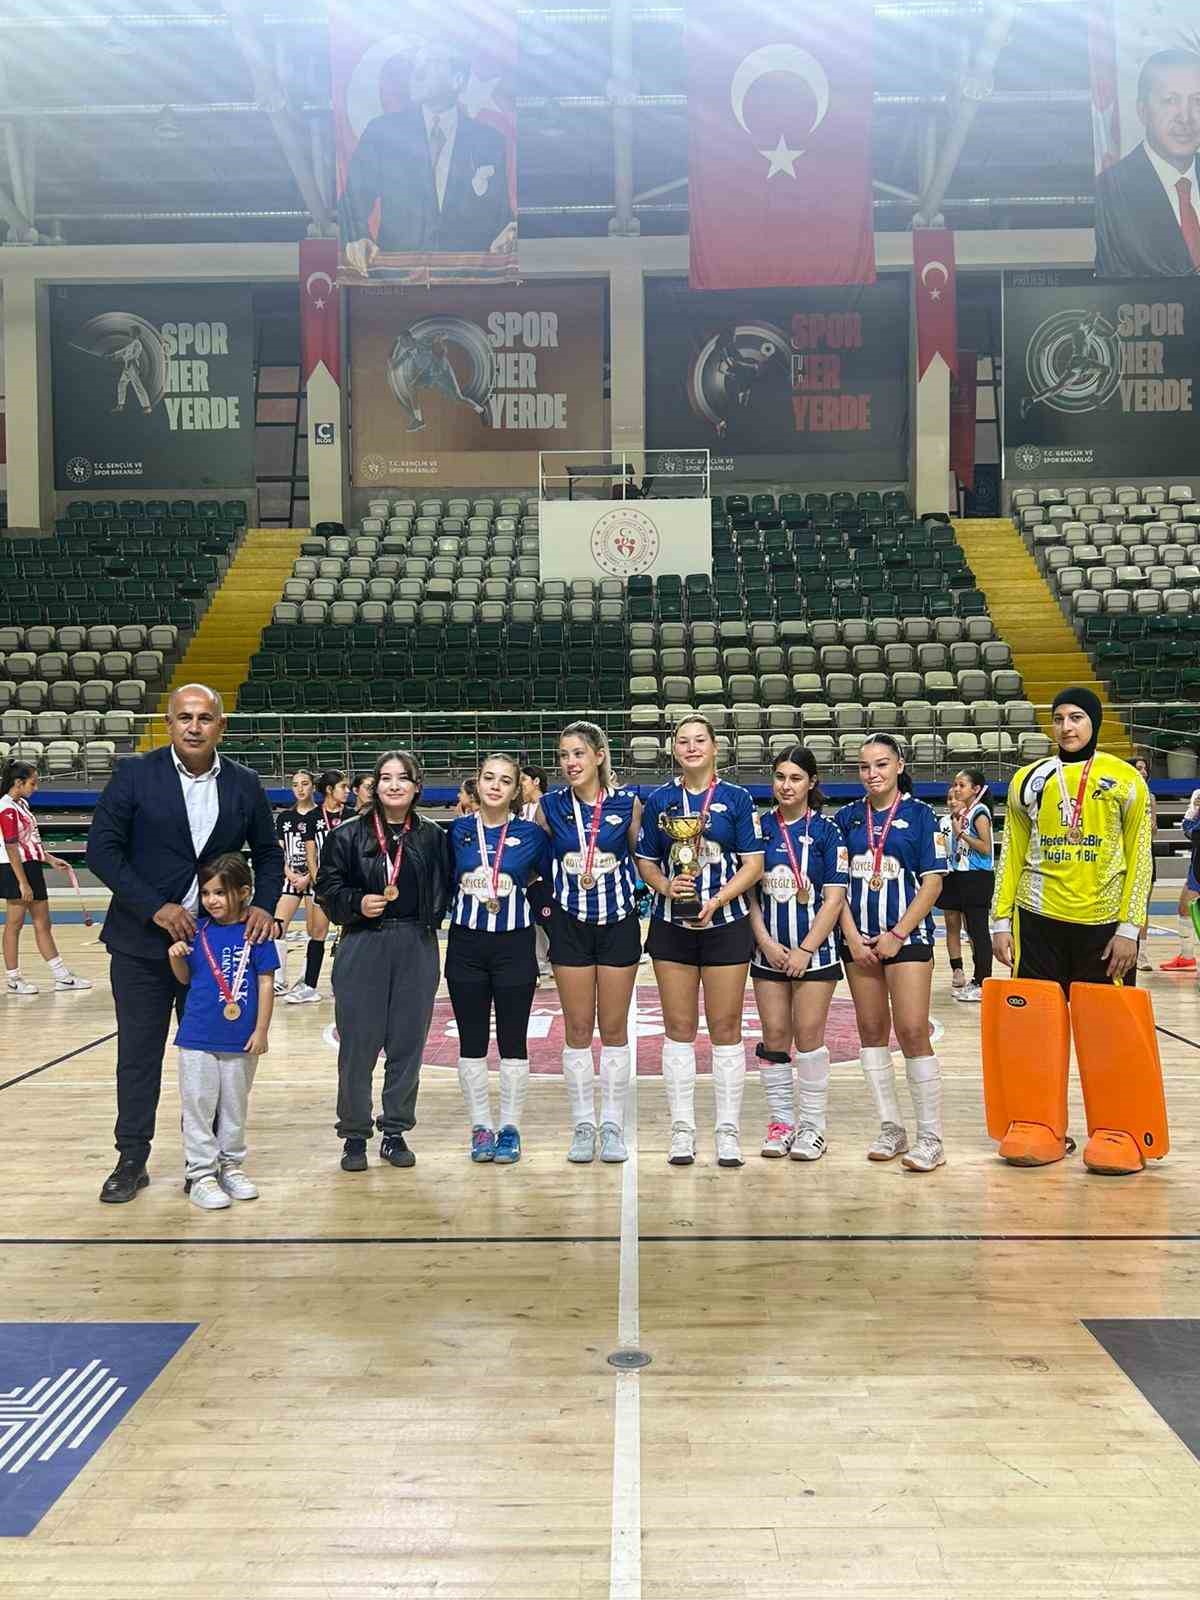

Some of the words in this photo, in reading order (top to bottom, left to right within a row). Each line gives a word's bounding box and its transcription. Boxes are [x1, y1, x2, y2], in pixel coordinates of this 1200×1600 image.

[487, 311, 559, 348] SPOR
[791, 314, 863, 349] SPOR
[1118, 303, 1184, 336] SPOR
[161, 322, 229, 356] SPOR
[792, 354, 840, 389] HER
[1119, 341, 1164, 374] HER
[165, 360, 209, 392] HER
[488, 393, 567, 429] YERDE
[1119, 379, 1192, 411] YERDE
[164, 396, 240, 430] YERDE
[791, 394, 871, 431] YERDE
[318, 424, 330, 438] C
